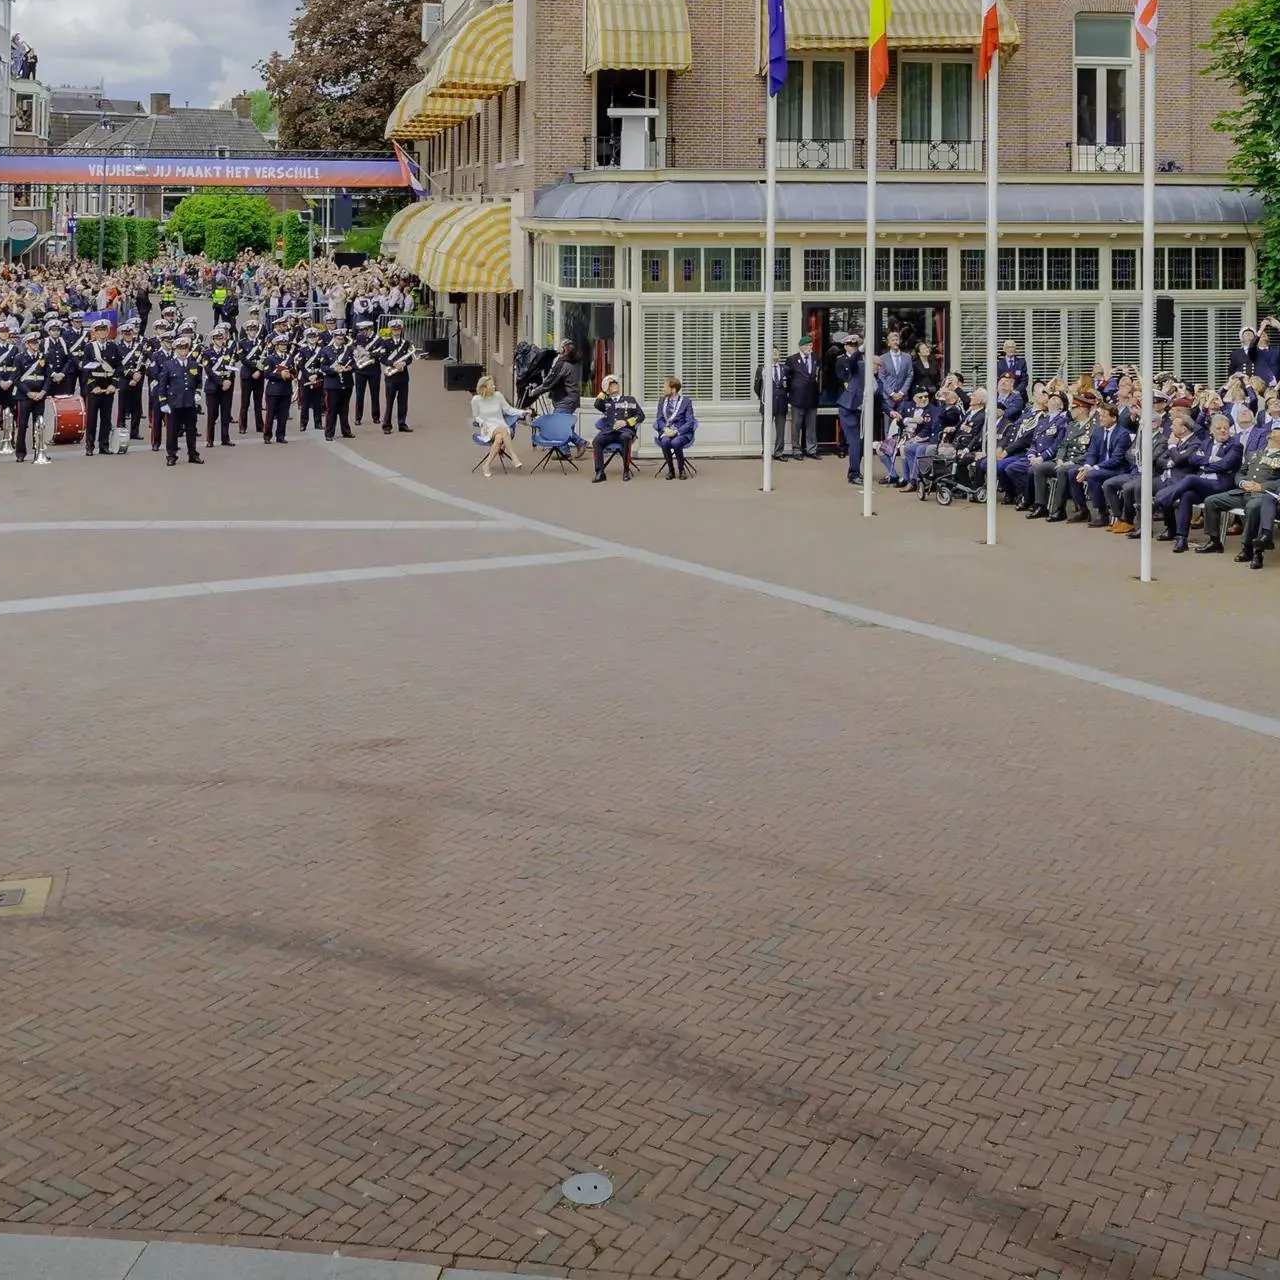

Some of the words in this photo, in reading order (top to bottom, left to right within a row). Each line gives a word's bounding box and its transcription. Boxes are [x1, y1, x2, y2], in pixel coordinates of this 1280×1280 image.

[153, 164, 172, 178] JIJ
[175, 165, 222, 179] MAAKT
[226, 165, 251, 179] HET
[254, 166, 320, 180] VERSCHIL!
